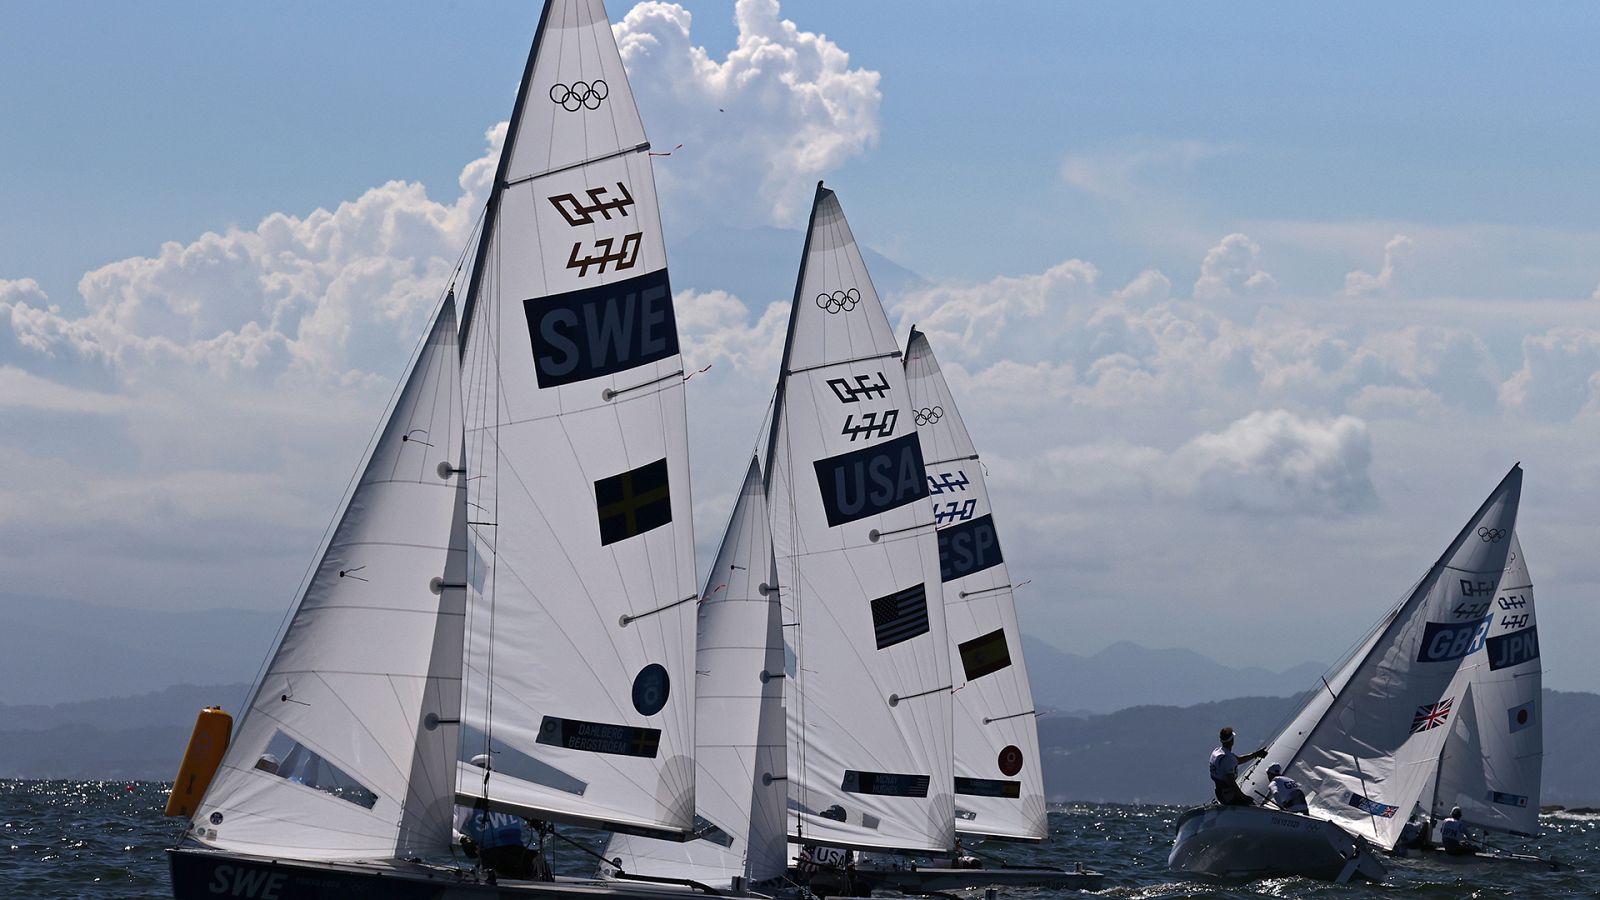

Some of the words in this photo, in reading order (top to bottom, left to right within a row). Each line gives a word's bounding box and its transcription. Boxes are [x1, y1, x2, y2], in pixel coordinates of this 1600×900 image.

[566, 232, 643, 277] 470
[539, 284, 666, 376] SWE
[841, 409, 899, 441] 470
[834, 446, 921, 516] USA
[933, 499, 977, 524] 470
[1453, 602, 1490, 619] 470
[1501, 614, 1529, 629] 470
[1428, 621, 1489, 659] GBR
[1496, 631, 1536, 665] JPN
[578, 723, 624, 739] DAHLBERG
[1284, 781, 1299, 790] GB
[817, 847, 845, 867] USA
[209, 864, 288, 900] SWE
